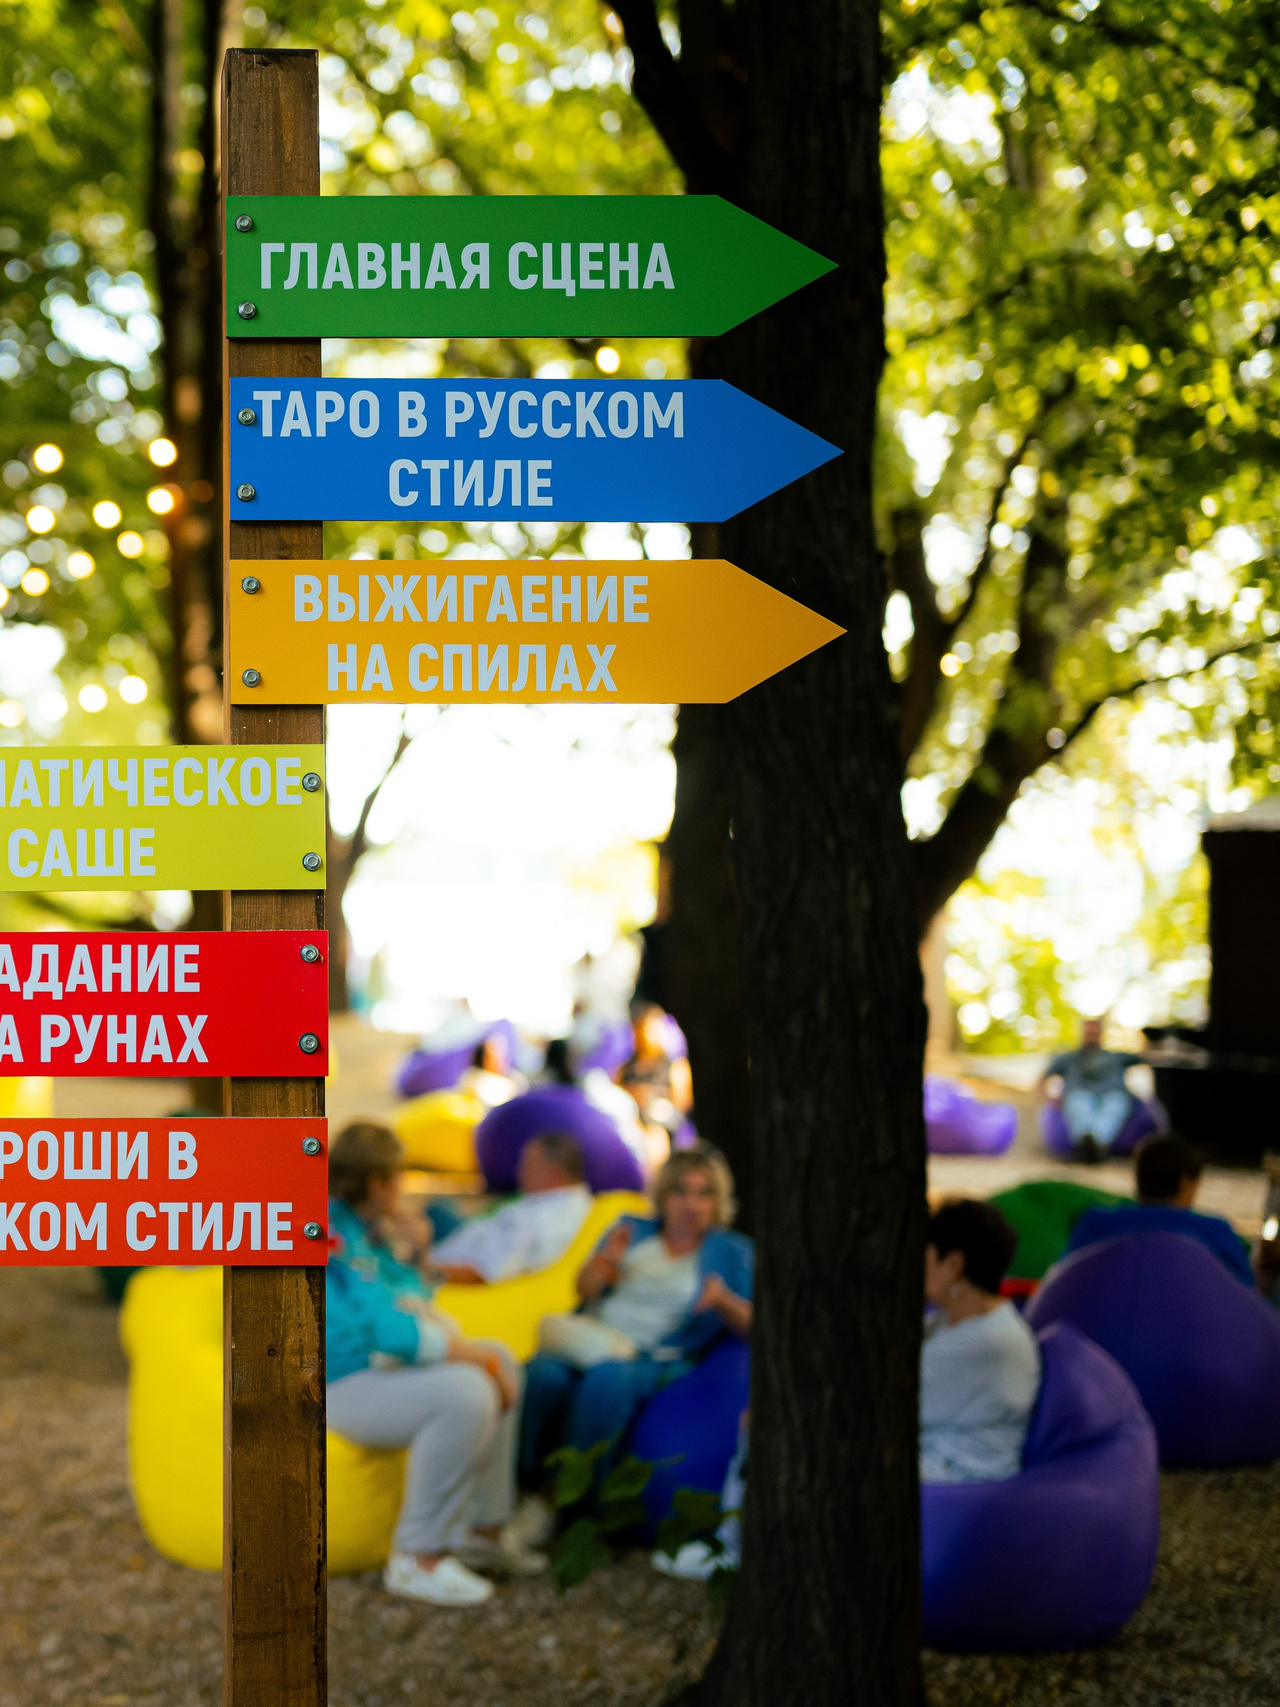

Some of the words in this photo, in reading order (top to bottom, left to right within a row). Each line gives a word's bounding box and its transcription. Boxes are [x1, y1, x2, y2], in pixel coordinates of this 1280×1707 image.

[260, 242, 491, 290] ГЛАВНАЯ
[507, 242, 675, 297] СЦЕНА
[253, 390, 381, 438] ТАРО
[398, 391, 428, 438] В
[445, 391, 685, 439] РУССКОМ
[388, 458, 554, 507] СТИЛЕ
[293, 575, 650, 623] ВЫЖИГАЕНИЕ
[327, 643, 394, 692] НА
[408, 643, 618, 693] СПИЛАХ
[7, 828, 156, 878] САШЕ
[40, 1014, 209, 1064] РУНАХ
[168, 1131, 199, 1181] В
[125, 1201, 294, 1252] СТИЛЕ
